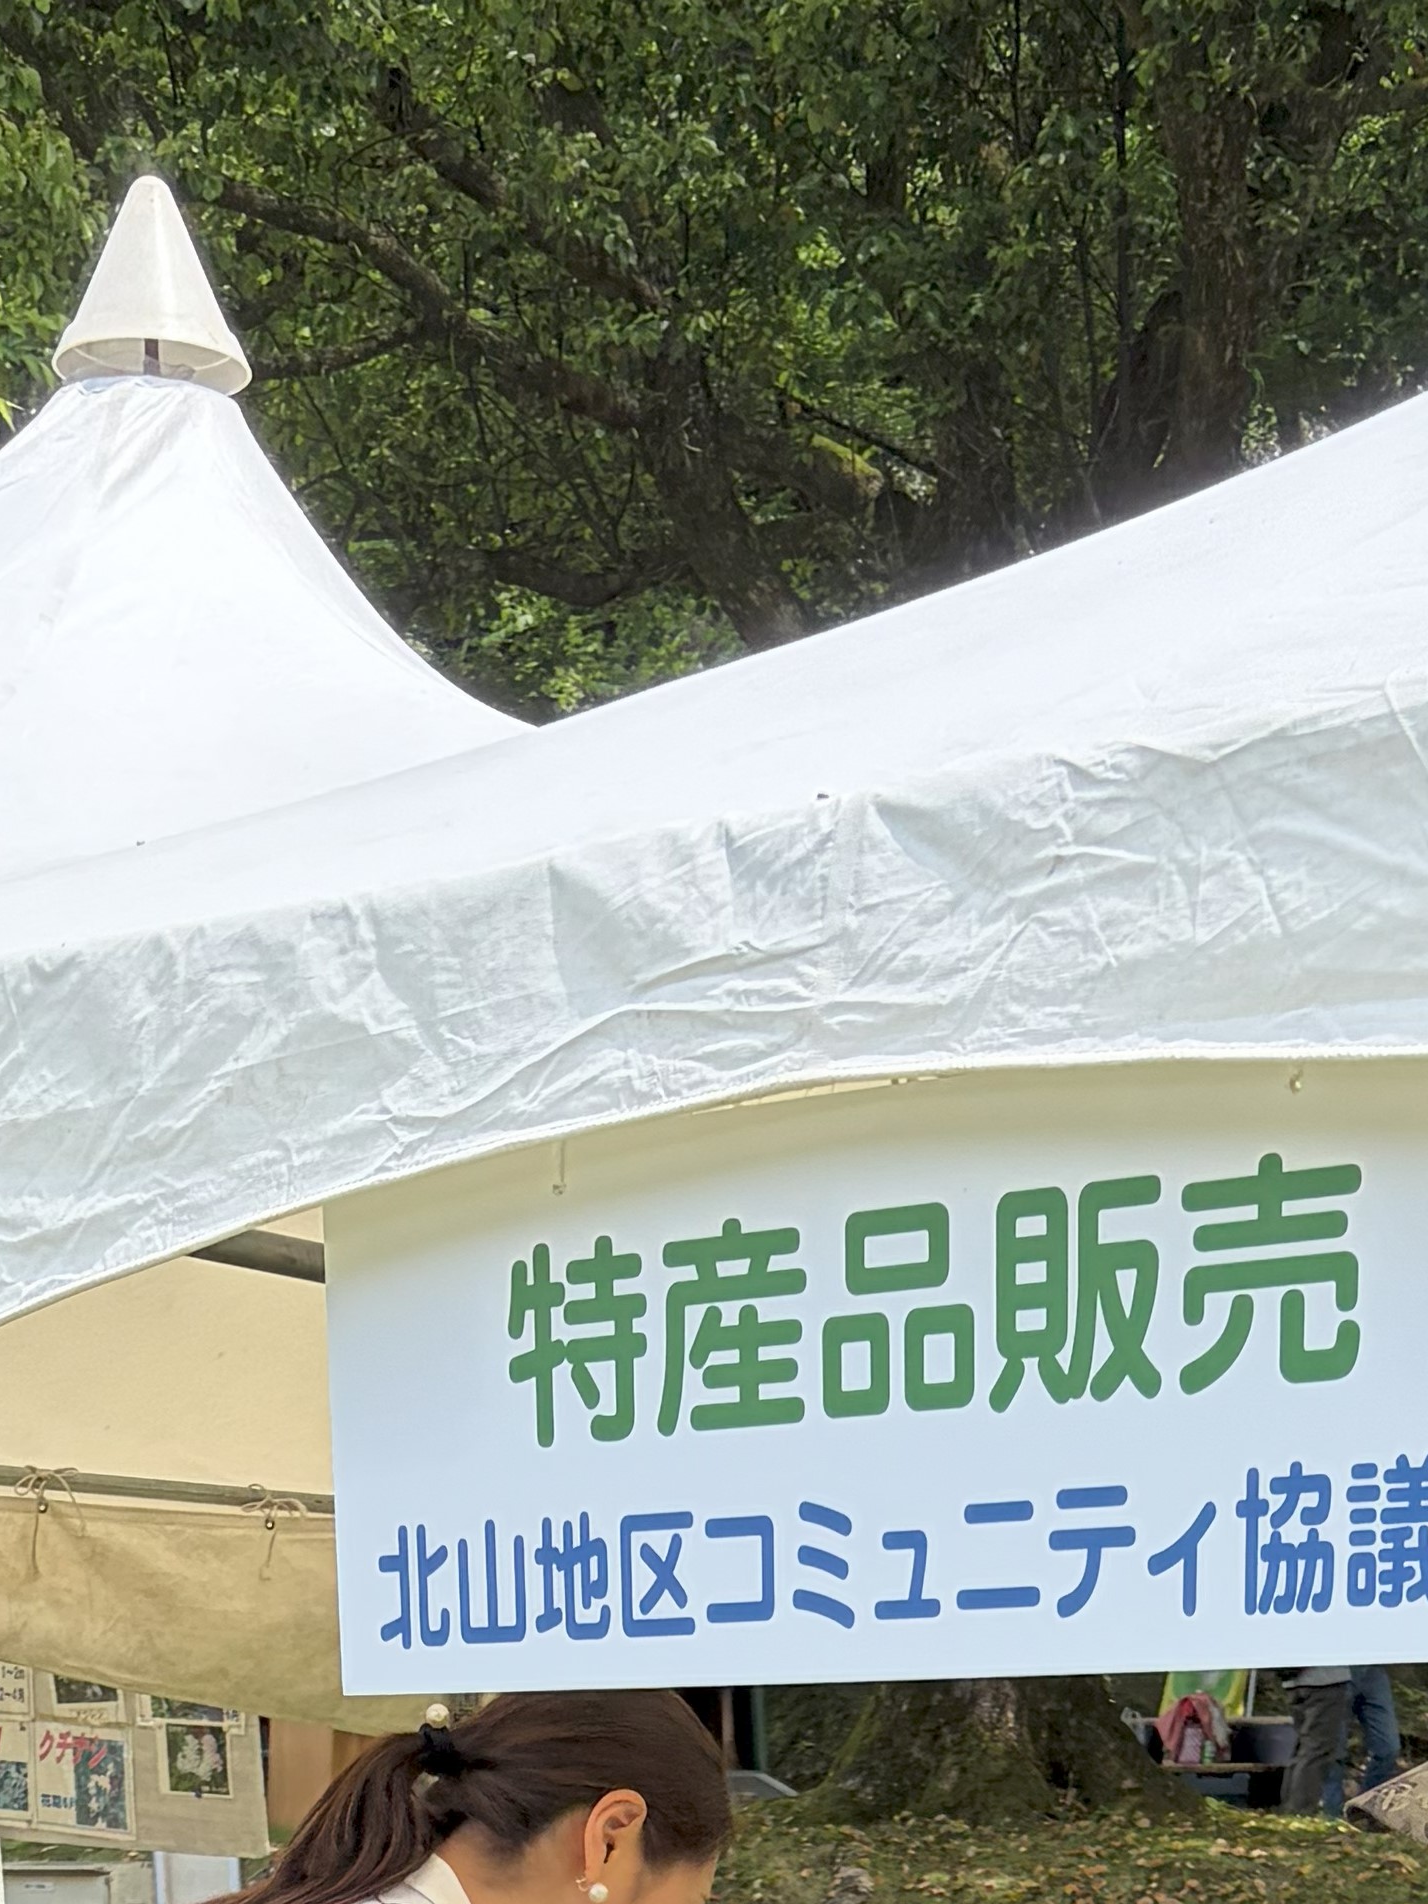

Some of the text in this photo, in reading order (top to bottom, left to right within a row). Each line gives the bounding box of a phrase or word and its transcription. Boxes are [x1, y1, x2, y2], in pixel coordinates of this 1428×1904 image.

[507, 1152, 1362, 1449] 特産品販売
